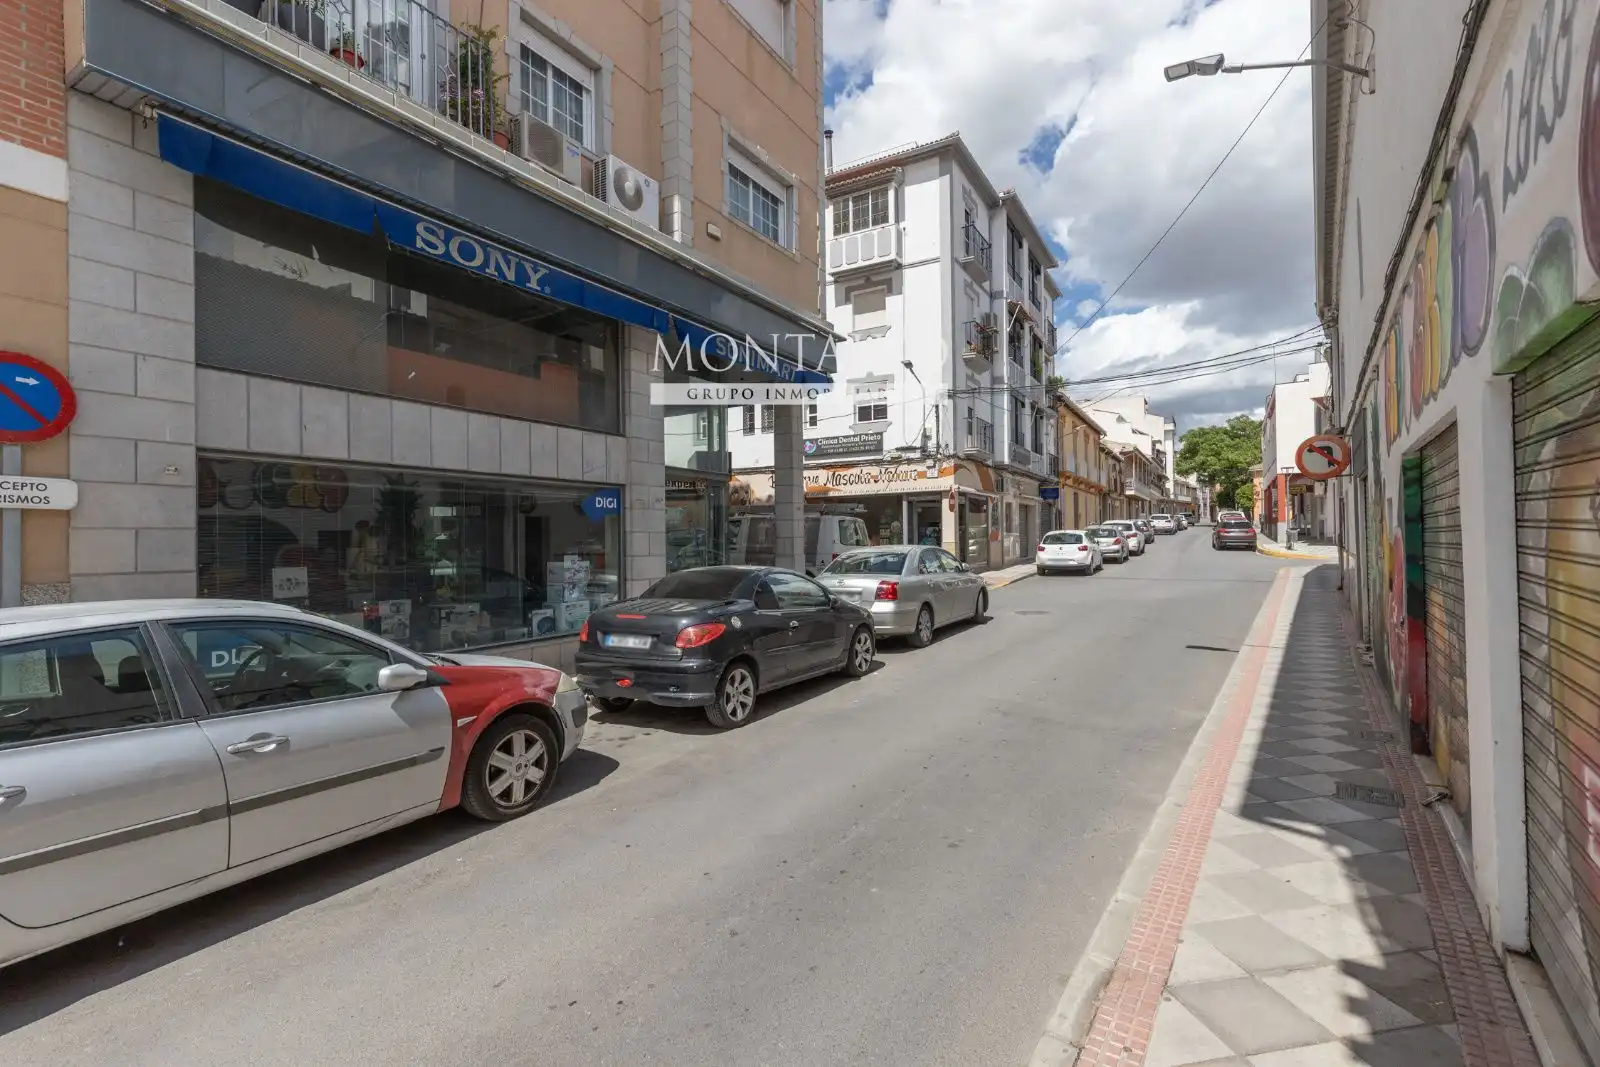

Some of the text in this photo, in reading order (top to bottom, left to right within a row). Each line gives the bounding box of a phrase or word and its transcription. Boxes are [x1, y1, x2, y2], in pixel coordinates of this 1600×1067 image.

[416, 221, 549, 291] SONY
[839, 435, 860, 444] Dental
[595, 496, 617, 509] DIGI
